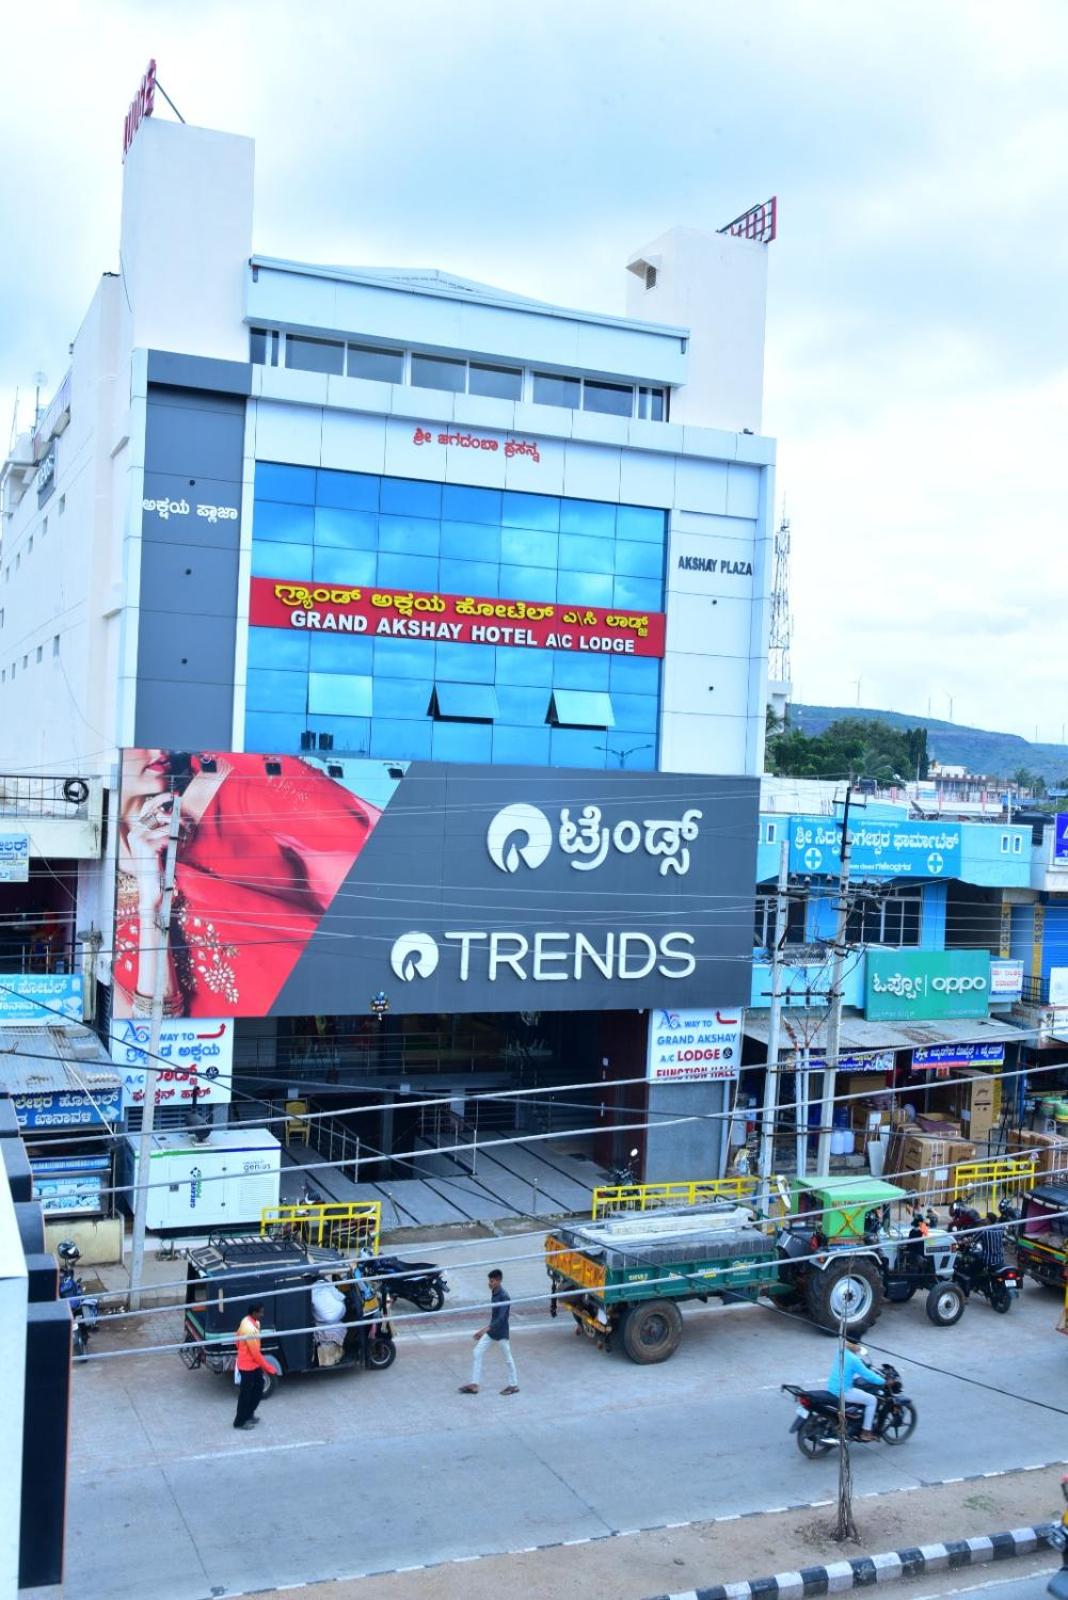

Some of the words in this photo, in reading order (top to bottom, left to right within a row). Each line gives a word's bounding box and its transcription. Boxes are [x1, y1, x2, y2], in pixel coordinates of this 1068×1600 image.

[142, 497, 190, 520] ಅಕ್ಷಯ
[678, 555, 718, 573] AKSHAY
[720, 559, 753, 577] PLAZA
[371, 592, 447, 618] ಅಕ್ಷಯ
[290, 609, 368, 632] GRAND
[376, 617, 463, 640] AKSHAY
[471, 625, 538, 646] HOTEL
[545, 633, 573, 648] A\C
[579, 636, 635, 653] LODGE
[445, 931, 697, 981] TRENDS
[182, 1032, 195, 1040] TO
[657, 1035, 694, 1046] GRAND
[697, 1033, 737, 1043] AKSHAY
[178, 1043, 221, 1062] ಅಕ್ಷಯ
[660, 1054, 675, 1062] A/C
[677, 1048, 721, 1062] LODGE
[125, 1074, 145, 1084] A/C
[656, 1066, 708, 1080] FUNCTION
